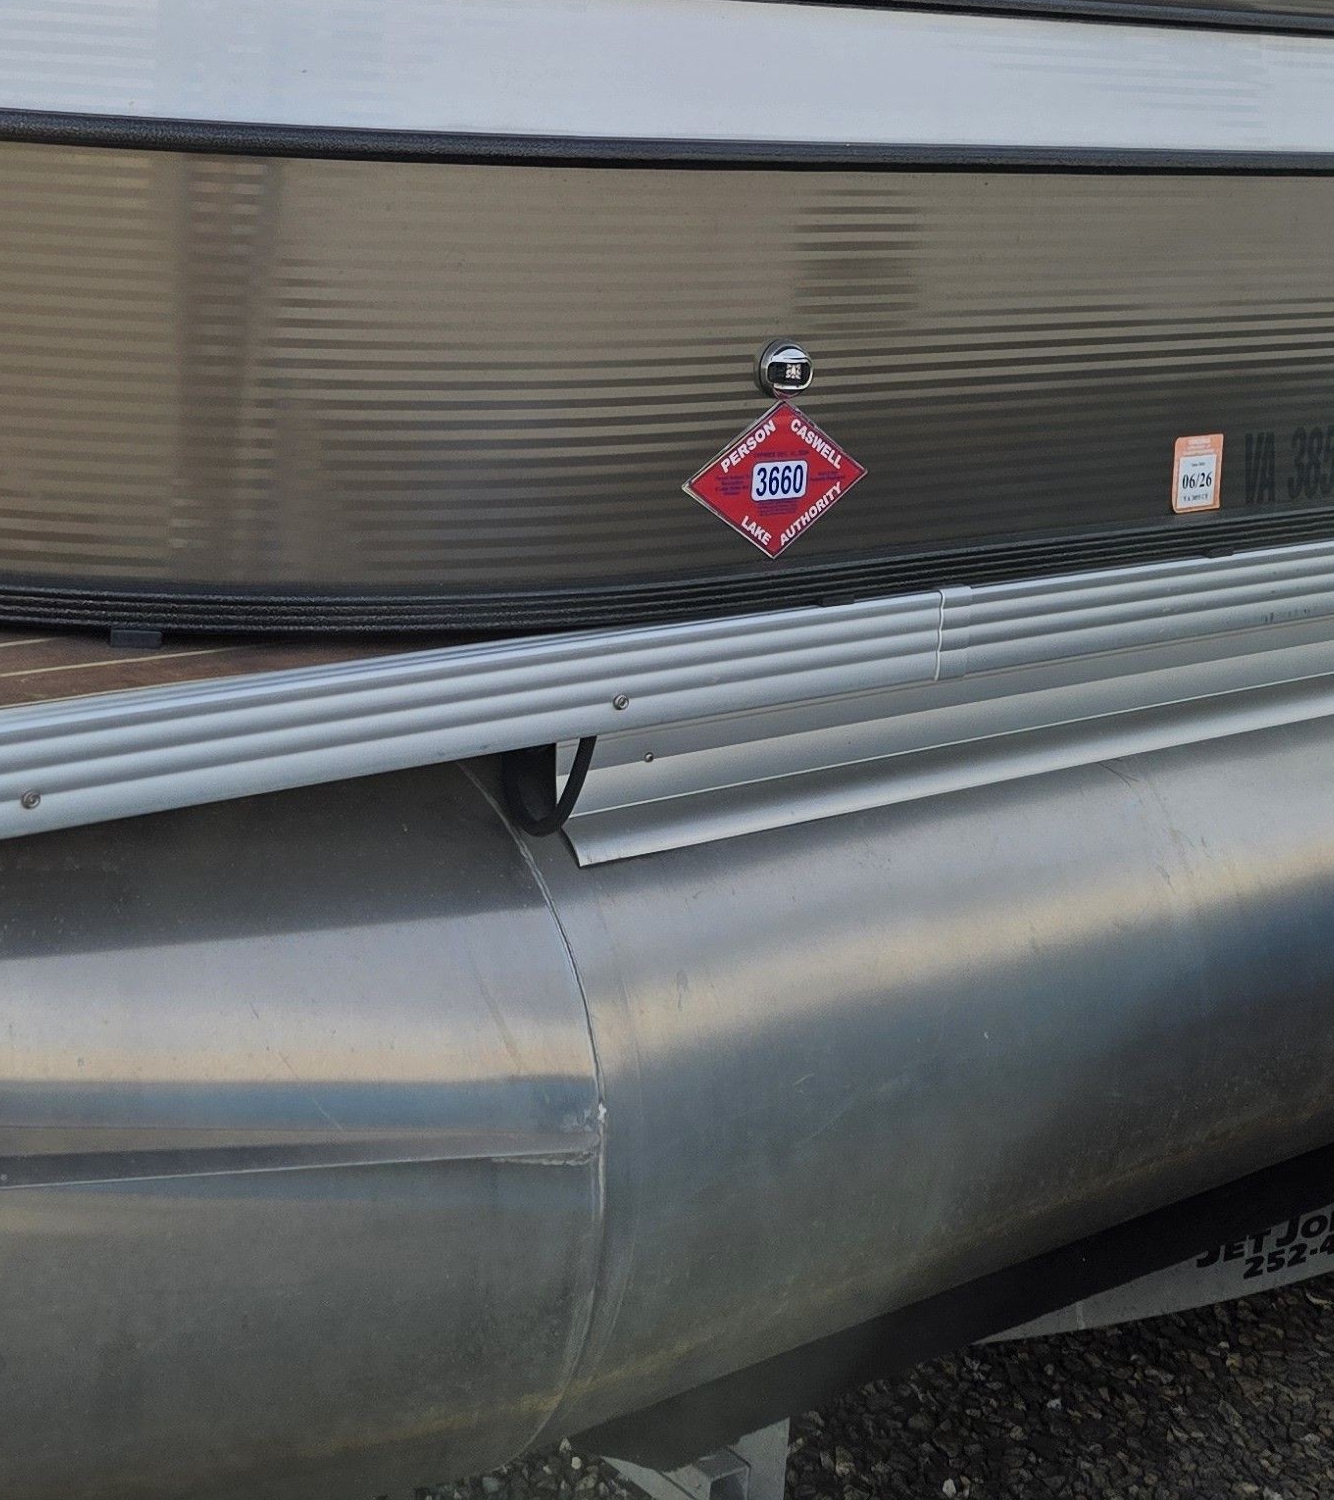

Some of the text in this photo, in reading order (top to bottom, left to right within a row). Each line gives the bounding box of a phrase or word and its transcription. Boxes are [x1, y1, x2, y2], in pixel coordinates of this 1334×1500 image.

[721, 420, 776, 473] PERSON
[790, 419, 842, 469] CASWELL
[756, 465, 804, 496] 3660
[1182, 471, 1213, 490] 06/26
[1245, 432, 1276, 503] VA
[741, 516, 772, 545] LAKE
[780, 482, 842, 546] AUTHORITY
[1197, 1230, 1272, 1268] JET
